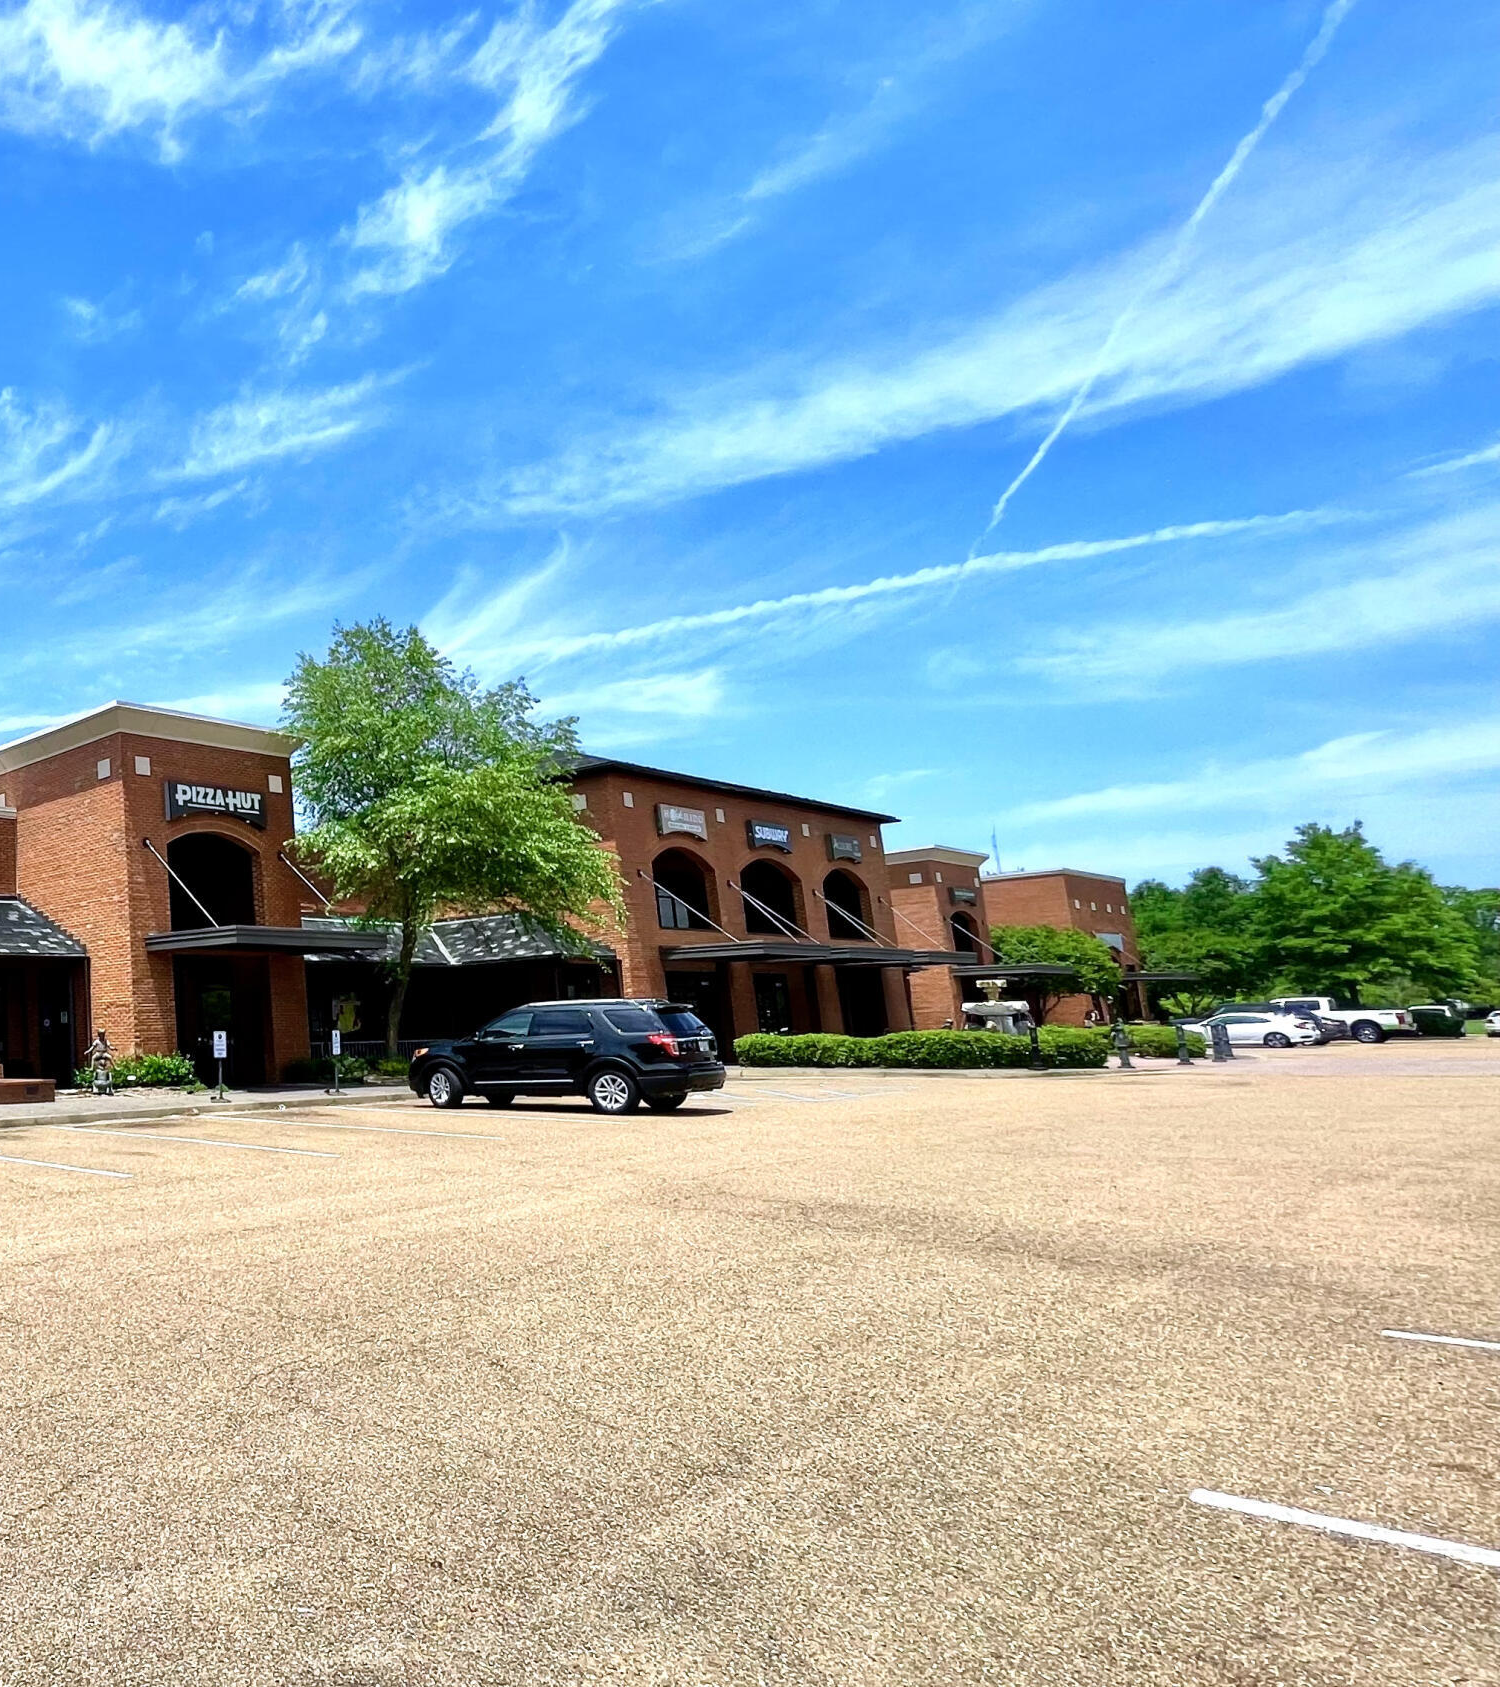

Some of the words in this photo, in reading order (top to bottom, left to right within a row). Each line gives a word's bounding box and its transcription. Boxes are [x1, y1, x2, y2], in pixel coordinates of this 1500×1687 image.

[175, 783, 226, 806] PIZZA
[225, 790, 261, 812] HUT
[754, 825, 789, 843] SUBWAY
